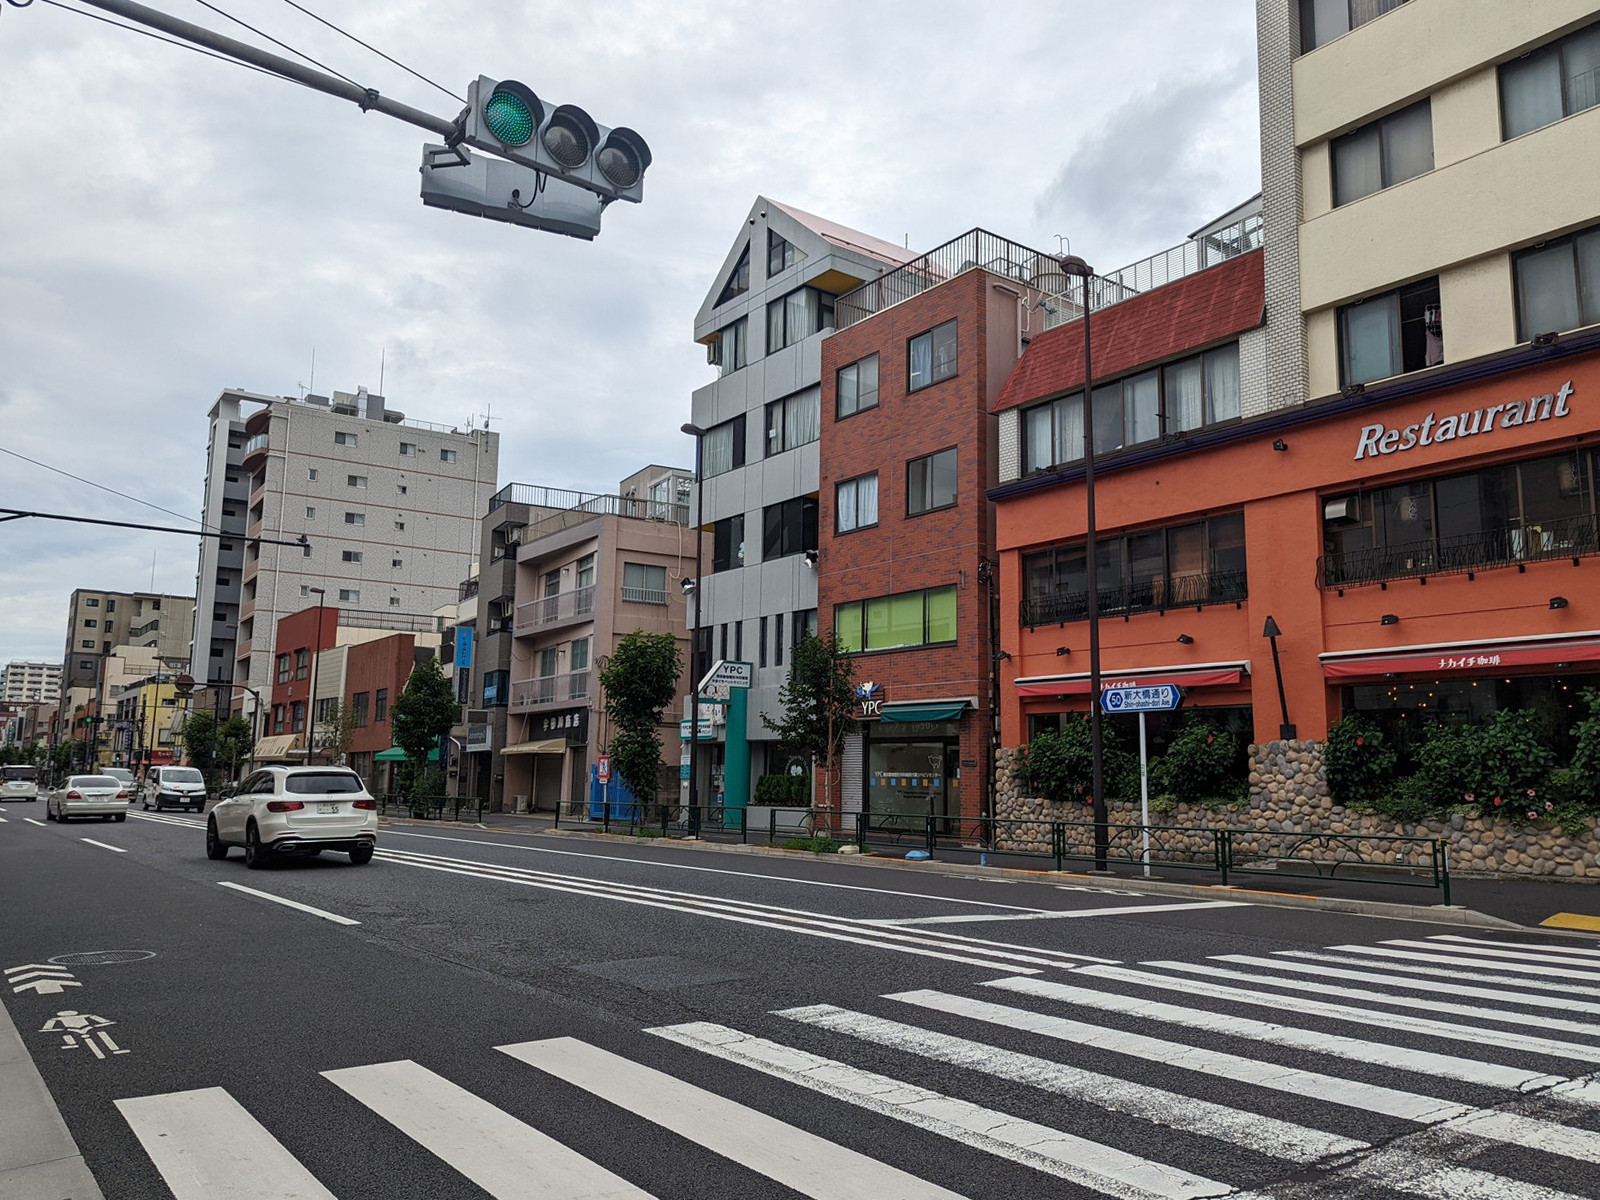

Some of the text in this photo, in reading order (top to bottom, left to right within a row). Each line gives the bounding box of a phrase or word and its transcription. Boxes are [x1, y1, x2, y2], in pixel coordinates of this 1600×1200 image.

[1353, 380, 1574, 460] Restaurant
[1438, 654, 1501, 669] ナカイチ珈琲
[723, 665, 743, 675] YPC
[1111, 695, 1122, 706] 50
[1124, 688, 1169, 700] 新大橋通り
[861, 700, 883, 715] YPC
